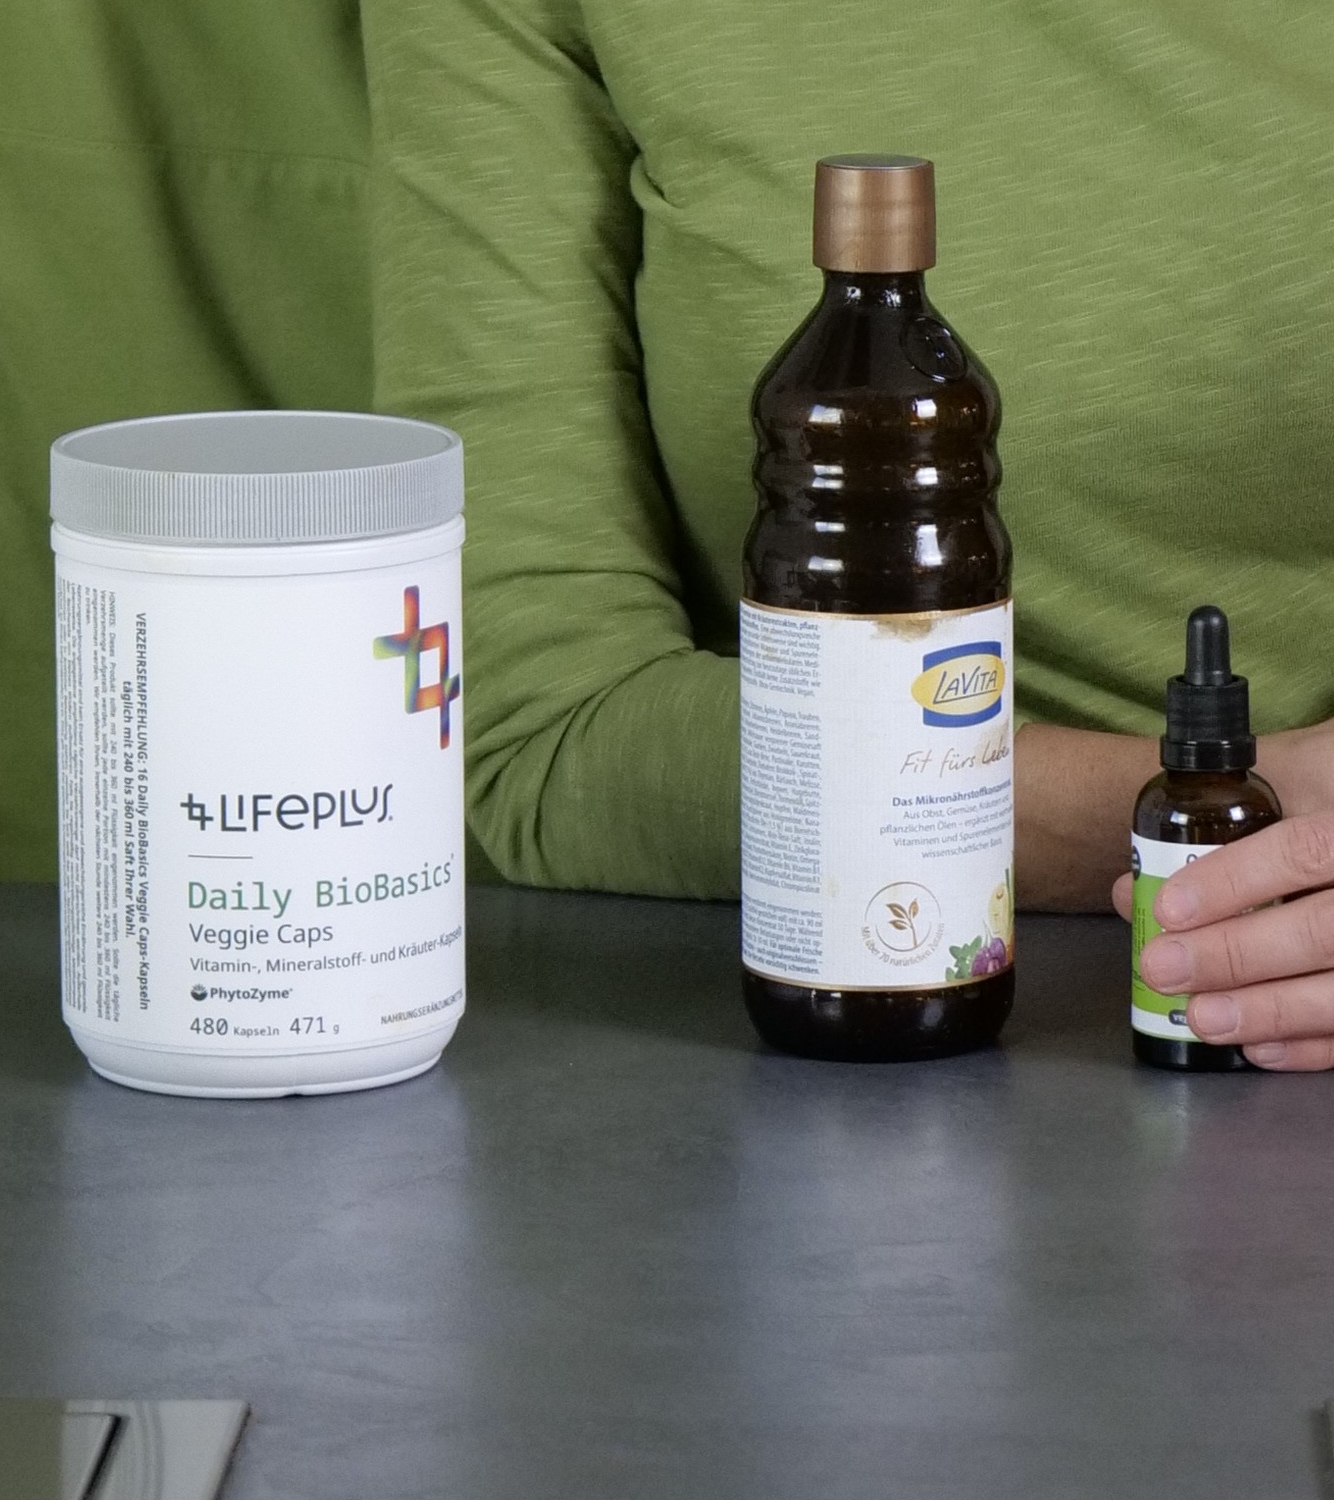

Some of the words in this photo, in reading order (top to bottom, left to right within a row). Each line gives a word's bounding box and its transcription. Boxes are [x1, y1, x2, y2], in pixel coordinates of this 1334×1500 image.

[136, 613, 148, 764] VERZEHRSEMPFEHLUNG:
[121, 681, 134, 723] täglich
[124, 727, 134, 749] mit
[124, 752, 134, 773] 240
[138, 768, 148, 781] 16
[899, 748, 933, 775] Fit
[938, 746, 976, 779] fürs
[124, 777, 135, 796] bis
[125, 799, 135, 819] 360
[136, 785, 150, 817] Daily
[891, 796, 914, 807] Das
[903, 811, 920, 820] Aus
[125, 822, 135, 837] ml
[879, 823, 936, 836] pflanzlichen
[893, 837, 940, 847] Vitaminen
[941, 833, 958, 844] und
[125, 841, 135, 866] Saft
[138, 820, 150, 878] BioBasics
[126, 869, 136, 901] Ihrer
[187, 881, 293, 919] Daily
[316, 860, 453, 909] BioBasics
[136, 881, 150, 924] Veggie
[126, 904, 136, 938] Wahl.
[189, 922, 269, 950] Veggie
[277, 924, 334, 948] Caps
[137, 927, 152, 1010] Caps-Kapseln
[189, 957, 262, 974] Vitamin-,
[266, 952, 367, 973] Mineralstoff-
[370, 947, 397, 964] und
[189, 1016, 229, 1036] 480
[233, 1025, 280, 1038] Kapseln
[289, 1015, 327, 1035] 471
[332, 1023, 341, 1036] g
